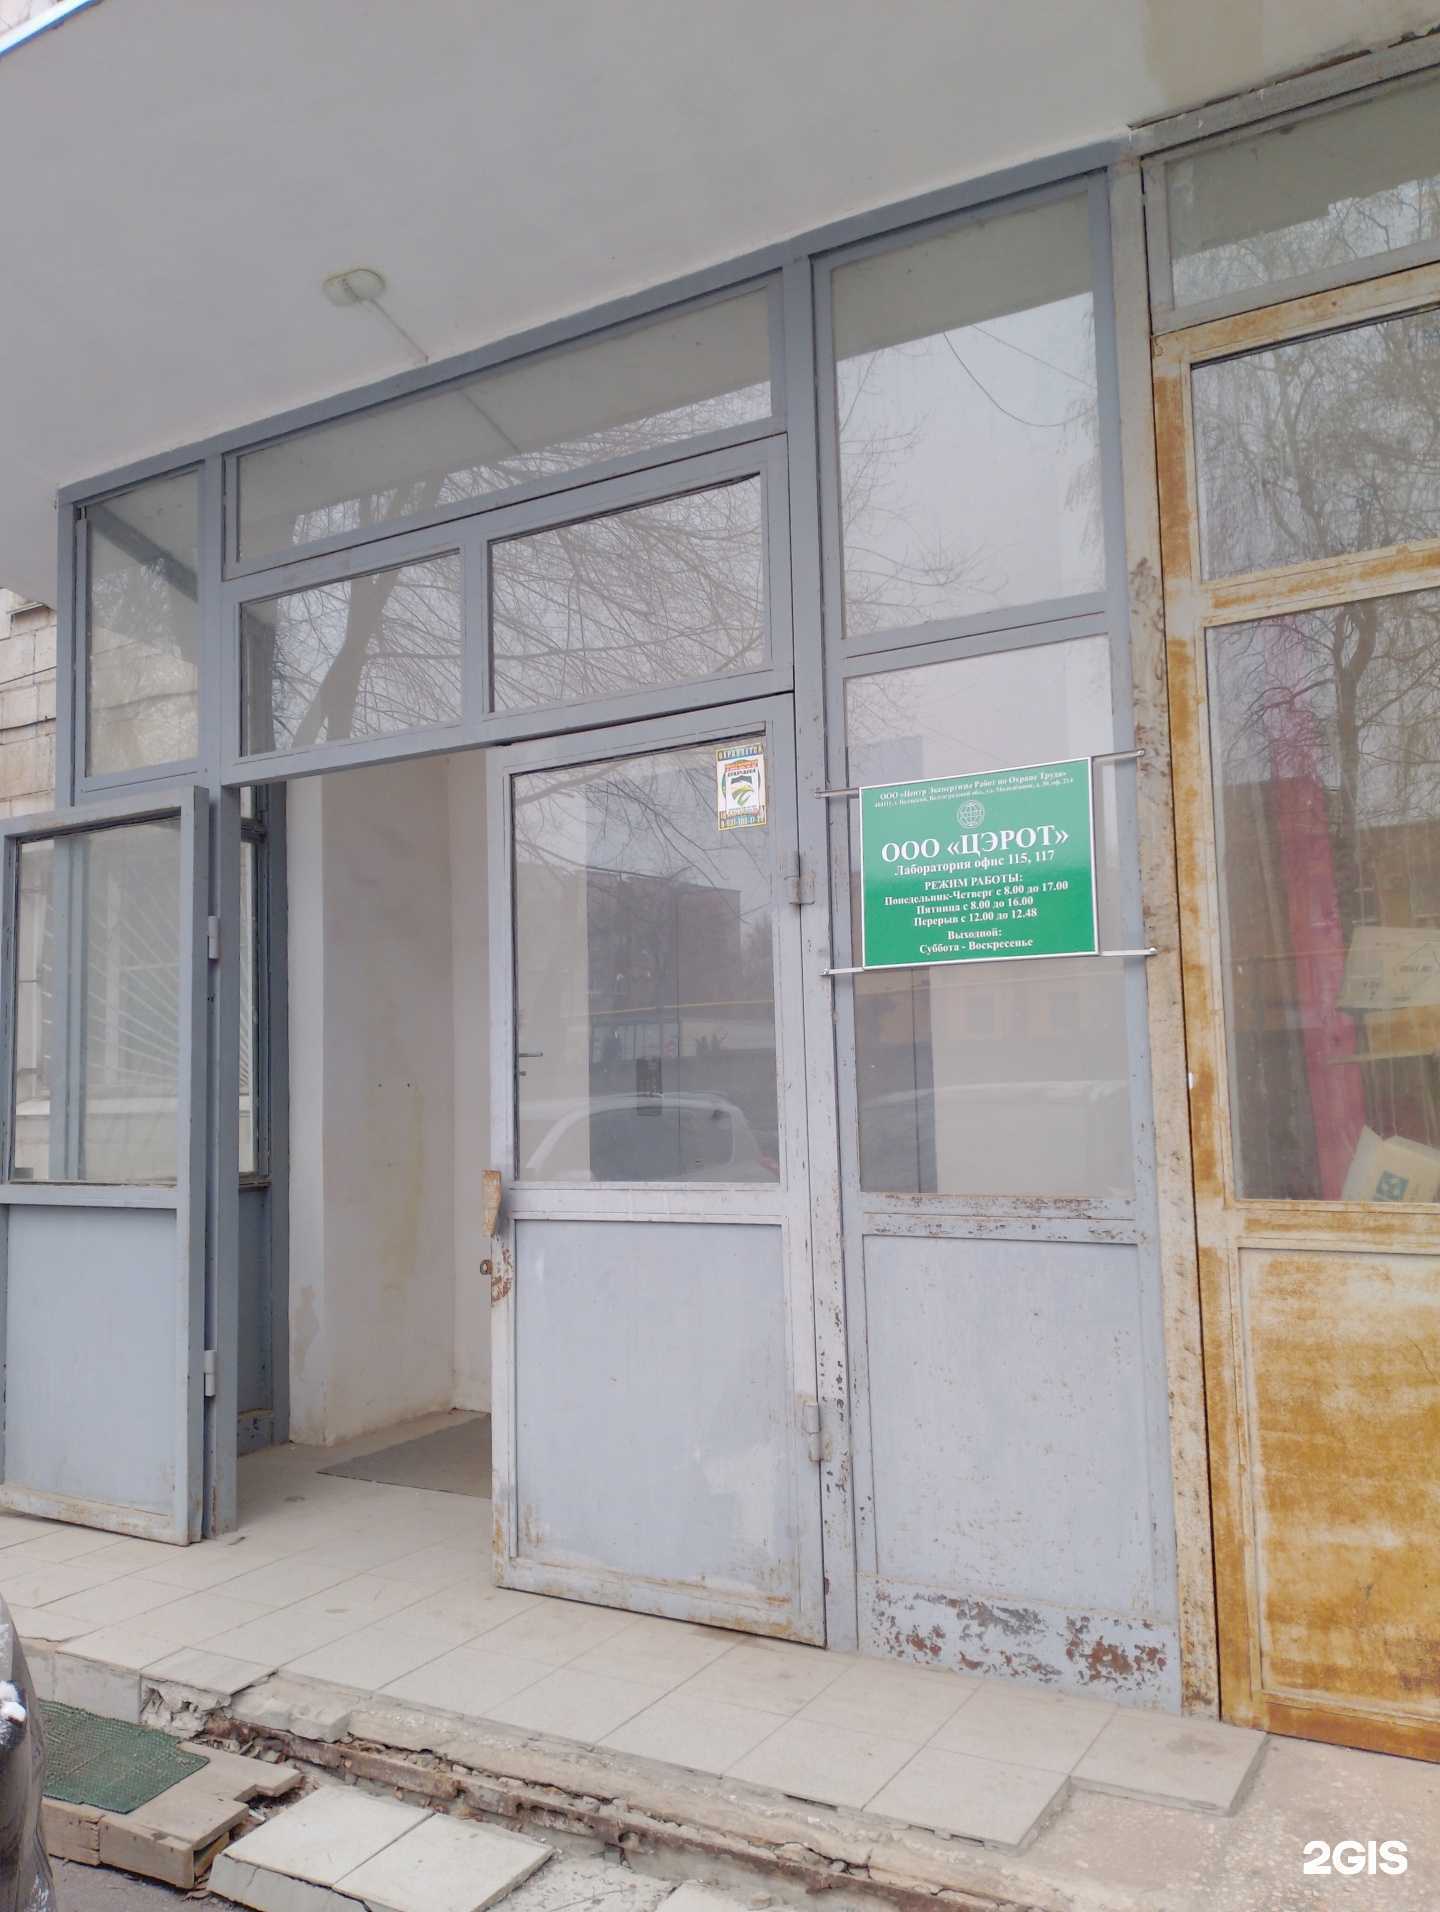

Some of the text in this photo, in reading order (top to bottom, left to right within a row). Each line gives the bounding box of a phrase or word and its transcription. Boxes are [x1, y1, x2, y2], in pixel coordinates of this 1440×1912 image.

[881, 825, 1068, 863] ООО «ЦЭРОТ»
[894, 849, 1055, 877] Лаборатория офис 115, 117
[924, 873, 1023, 891] РЕЖИМ РАБОТЫ:
[884, 880, 1069, 906] Понедельник-Четверг с 8.00 до 17.00
[916, 896, 1034, 915] Пятница с 8.00 до 16.00
[913, 908, 1038, 928] Перерыв с 12.00 до 12.48
[947, 927, 1002, 940] Выходной:
[919, 940, 959, 956] Суббота
[968, 938, 1034, 951] Воскресенье
